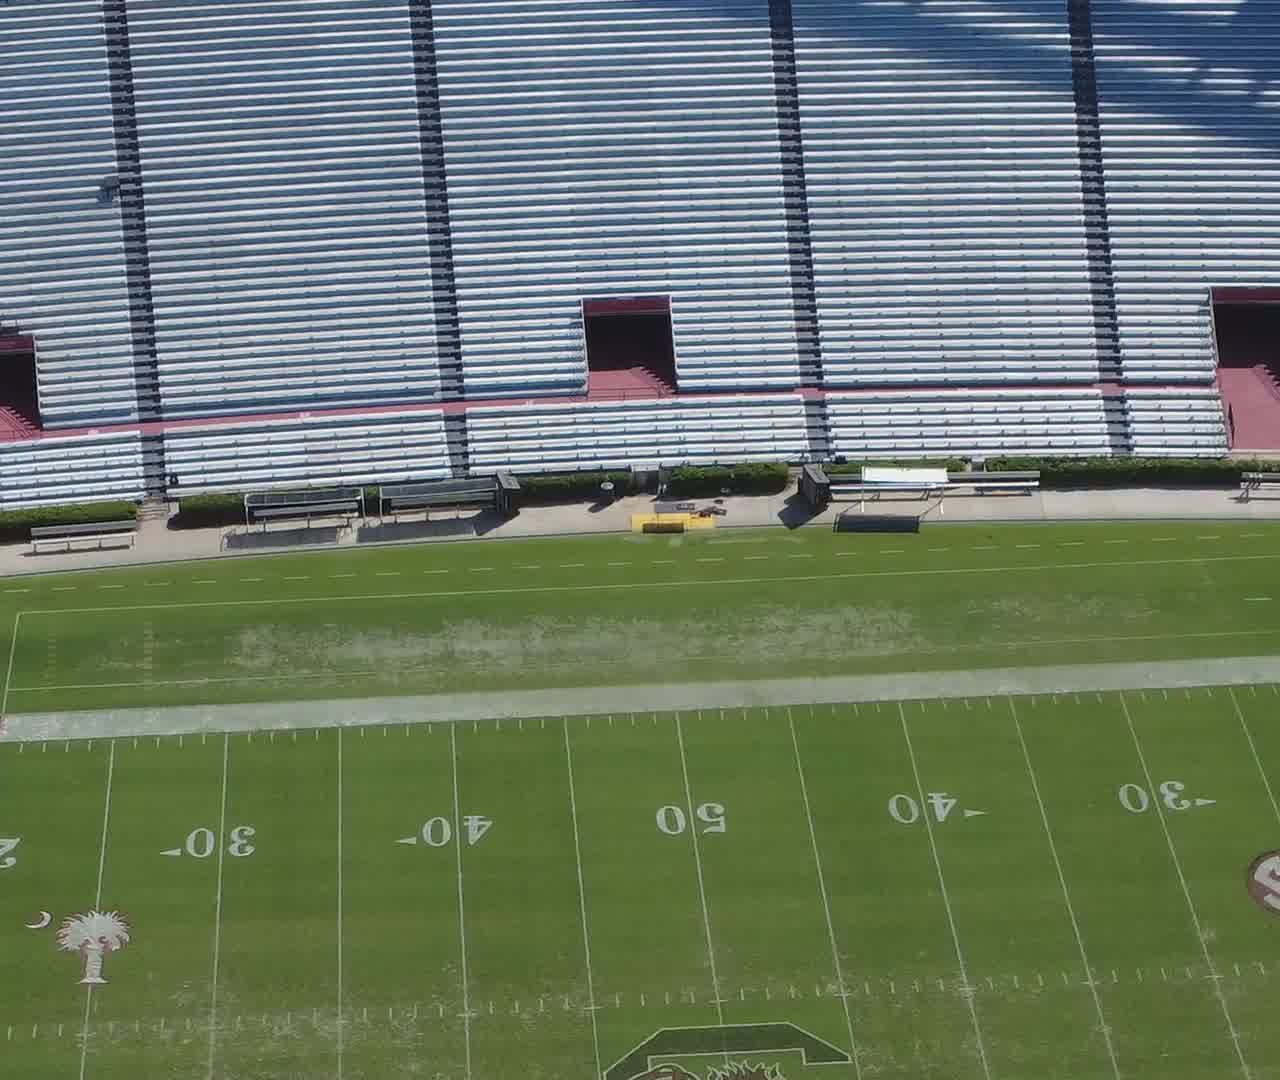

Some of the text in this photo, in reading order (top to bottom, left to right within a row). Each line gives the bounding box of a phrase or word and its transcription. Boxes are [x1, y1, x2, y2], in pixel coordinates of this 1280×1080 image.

[888, 791, 960, 825] 40
[1119, 780, 1193, 814] 30
[422, 815, 494, 848] 40
[655, 801, 727, 835] 50
[185, 825, 256, 859] 30
